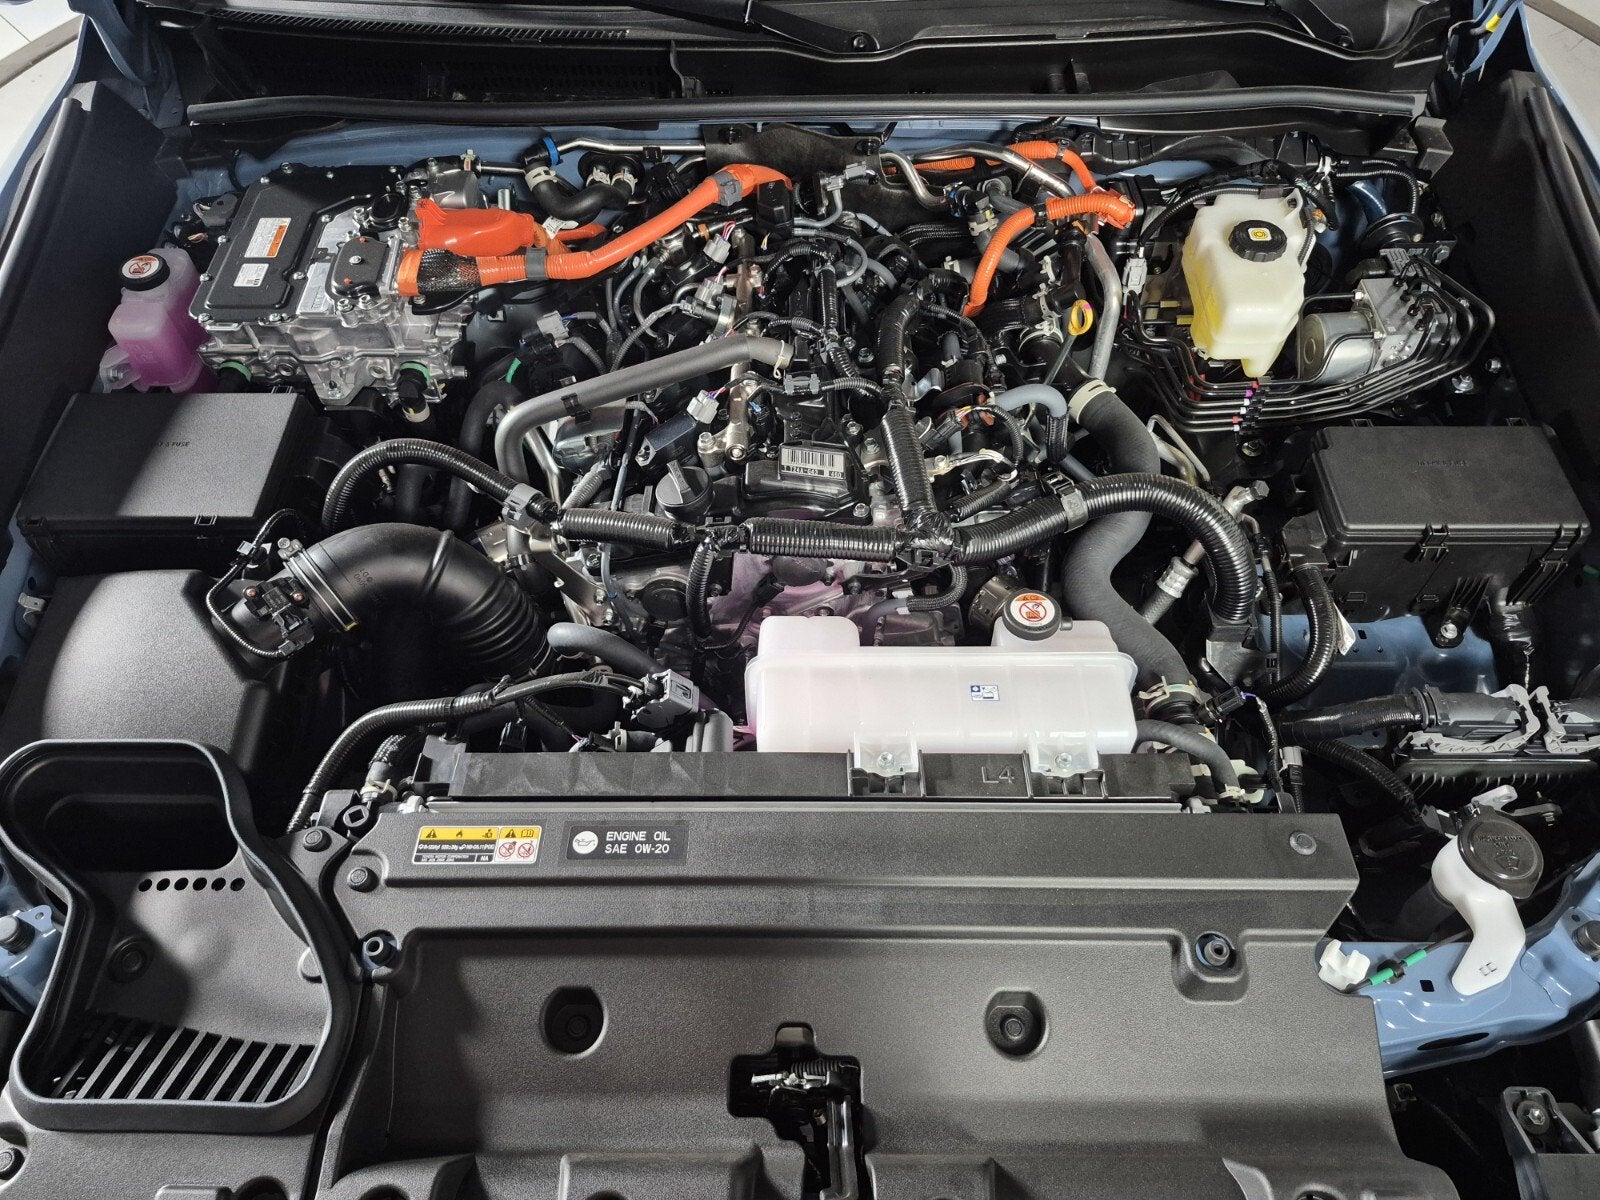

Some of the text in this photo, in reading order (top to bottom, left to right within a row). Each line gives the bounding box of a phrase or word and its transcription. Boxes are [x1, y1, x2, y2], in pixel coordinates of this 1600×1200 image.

[981, 766, 1015, 784] L4
[606, 831, 671, 841] ENGINE OIL
[604, 844, 670, 854] SAE 0W-20
